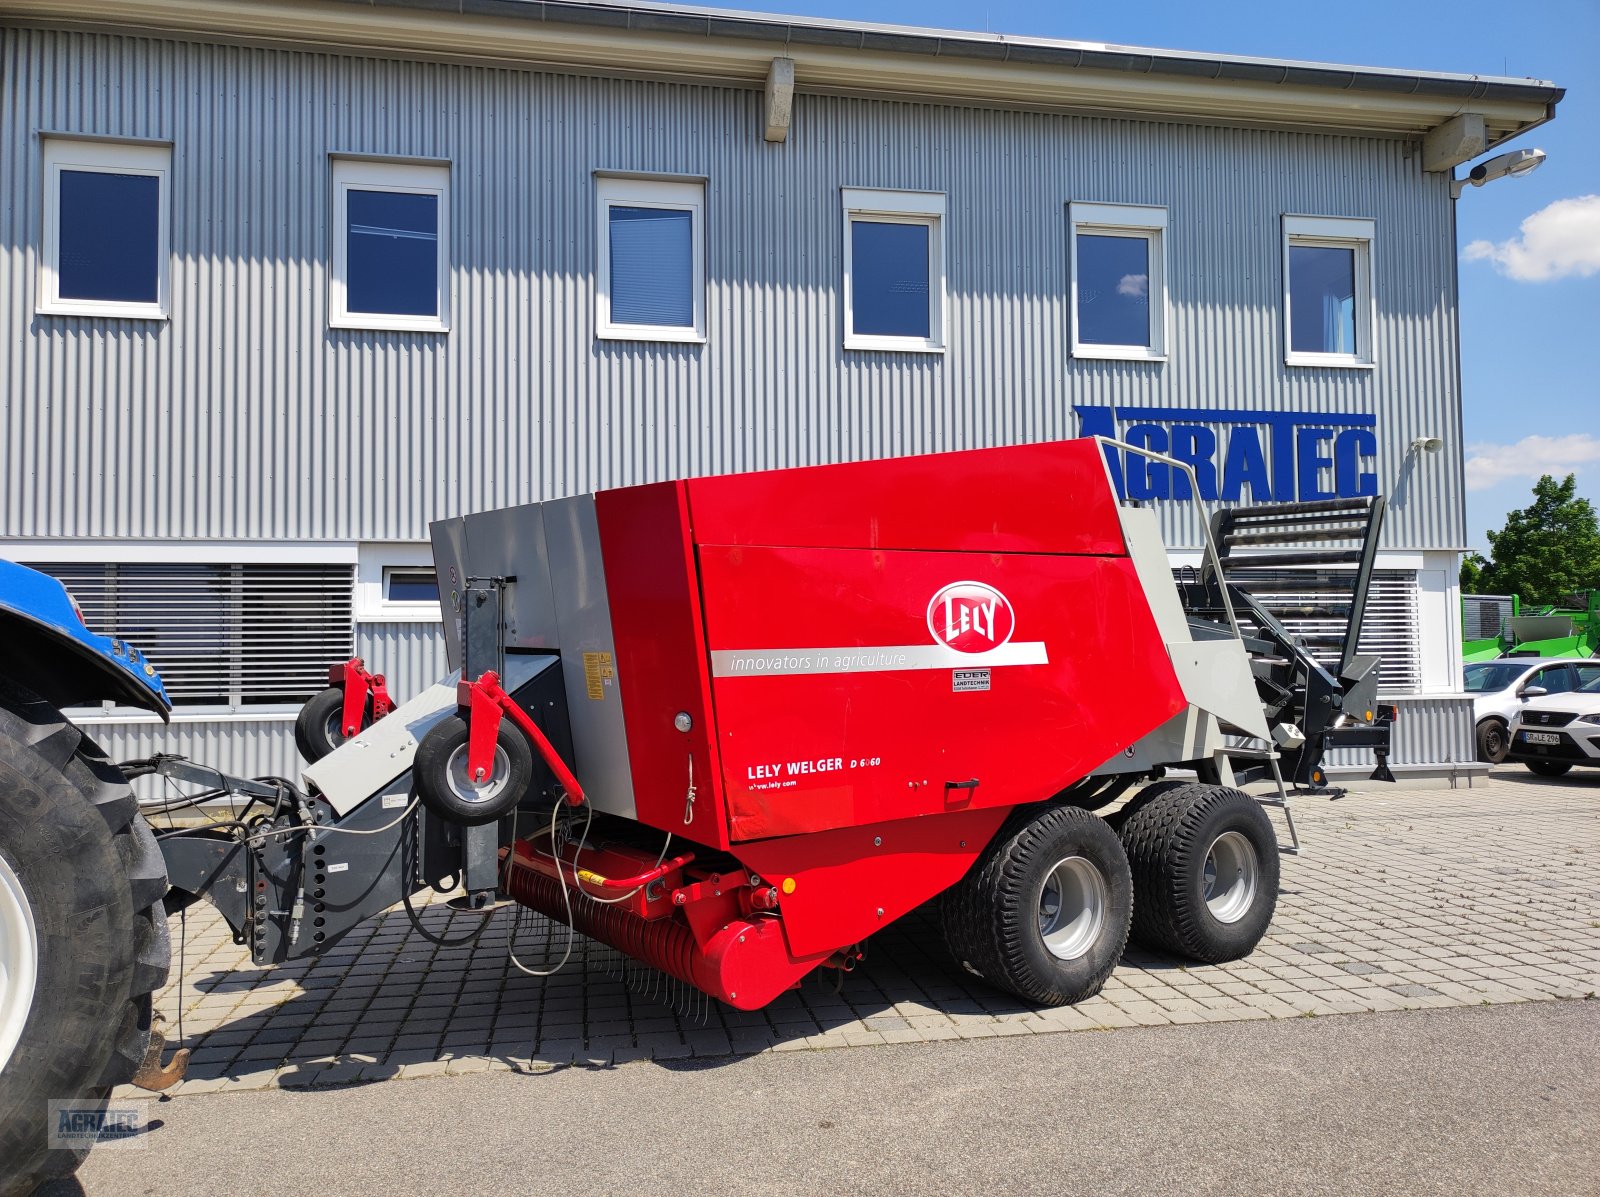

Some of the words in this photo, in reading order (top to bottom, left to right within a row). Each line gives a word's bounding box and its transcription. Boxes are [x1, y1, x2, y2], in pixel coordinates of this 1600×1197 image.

[945, 595, 996, 643] LELY
[730, 655, 811, 671] innovators
[816, 653, 829, 668] in
[834, 651, 906, 671] agriculture
[747, 763, 782, 780] LELY
[786, 757, 843, 775] WELGER
[850, 759, 857, 768] D
